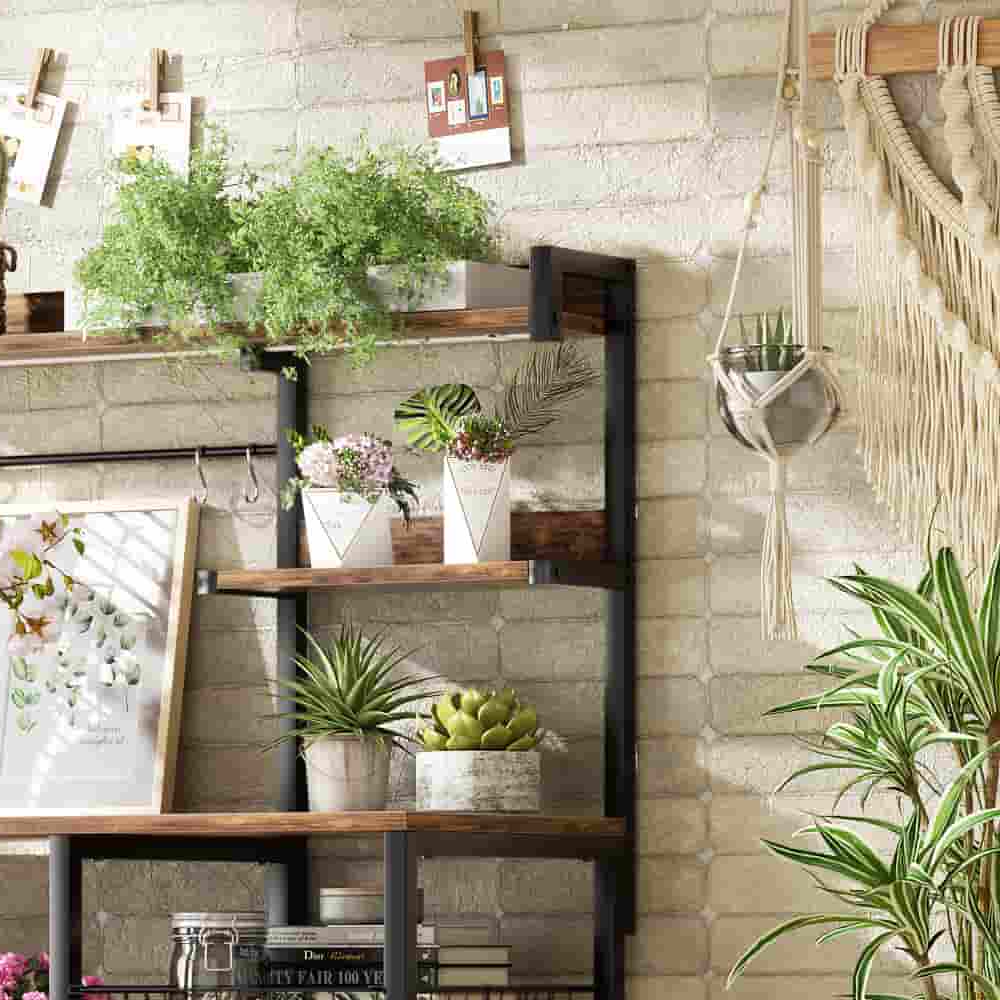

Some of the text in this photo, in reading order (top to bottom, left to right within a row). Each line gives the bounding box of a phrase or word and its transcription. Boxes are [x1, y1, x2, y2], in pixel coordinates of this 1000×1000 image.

[296, 967, 335, 985] FAIR
[338, 967, 360, 985] 100
[361, 967, 385, 985] YE
